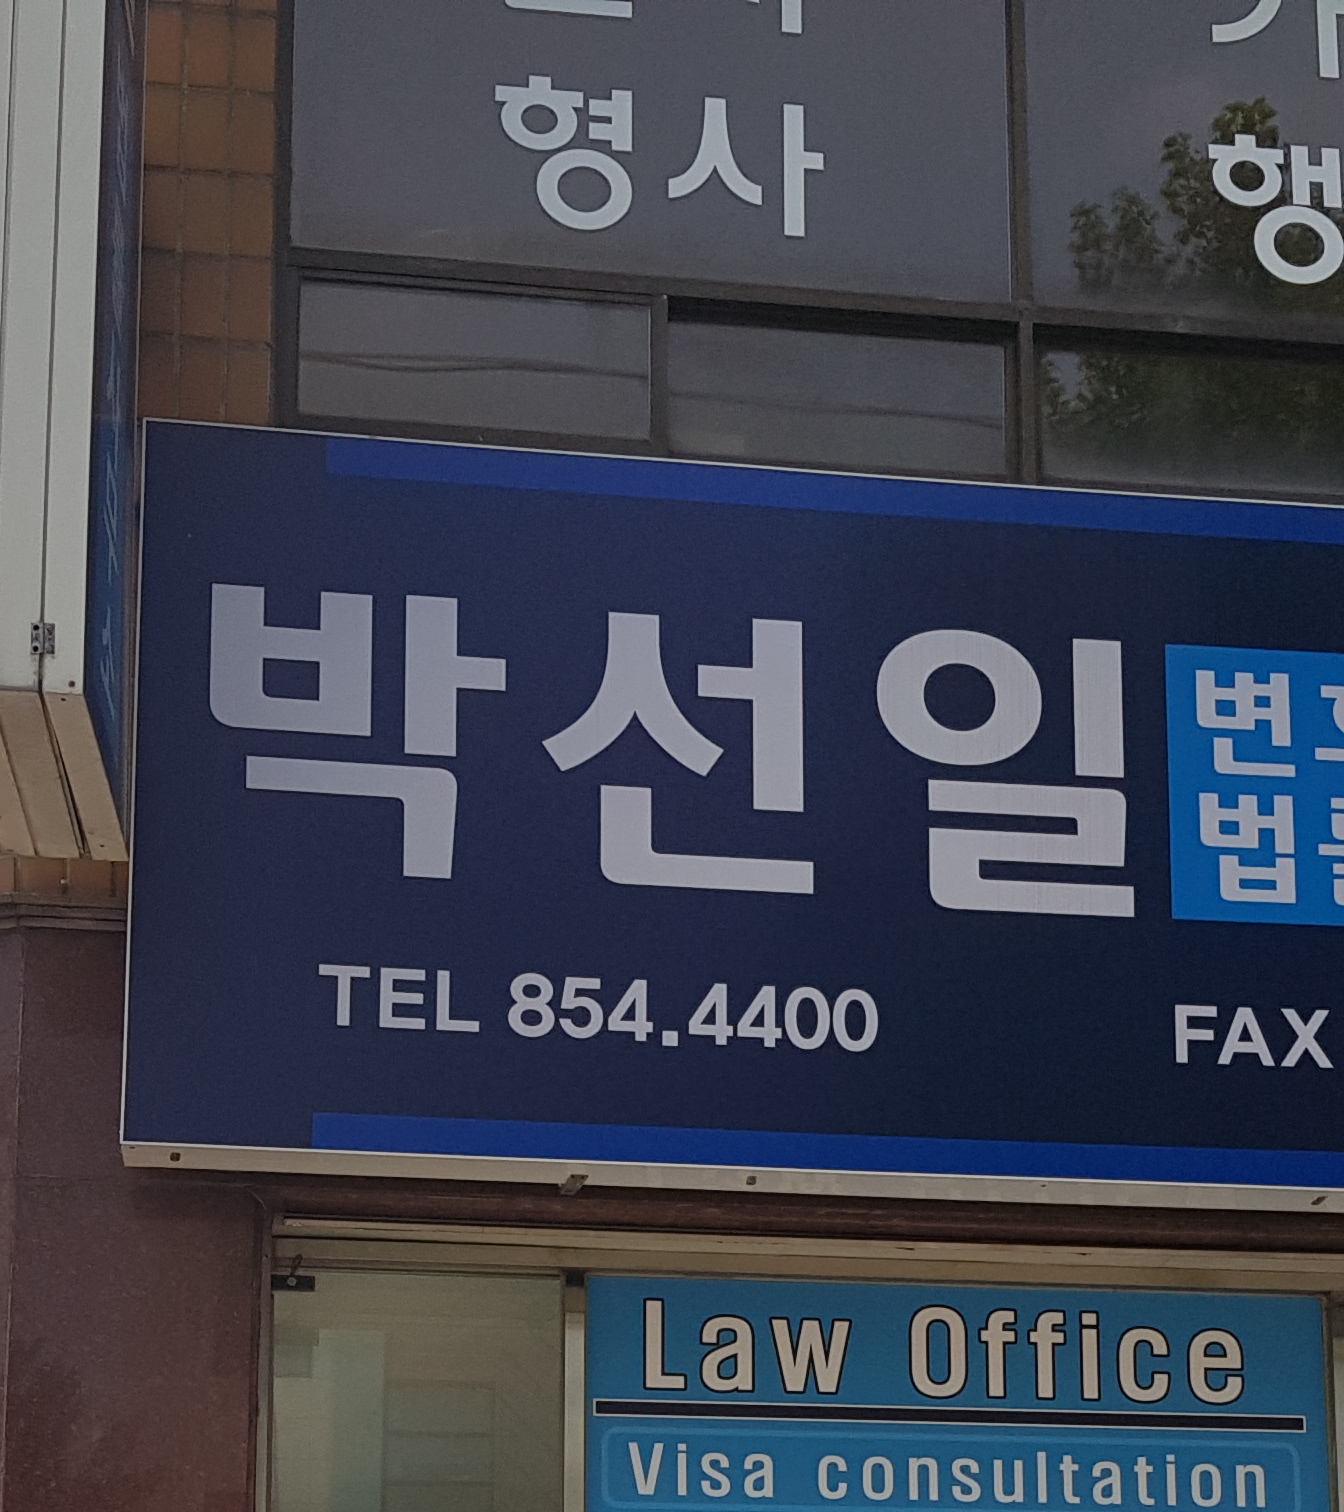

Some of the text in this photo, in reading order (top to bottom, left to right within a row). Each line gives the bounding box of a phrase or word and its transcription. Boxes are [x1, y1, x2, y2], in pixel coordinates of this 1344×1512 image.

[494, 75, 825, 237] 형사
[210, 583, 1135, 918] 박선일
[318, 963, 879, 1053] TEL 854.4400
[1174, 1004, 1334, 1069] FAX
[643, 1298, 1246, 1404] Law Office
[628, 1442, 1268, 1508] Visa consultation
